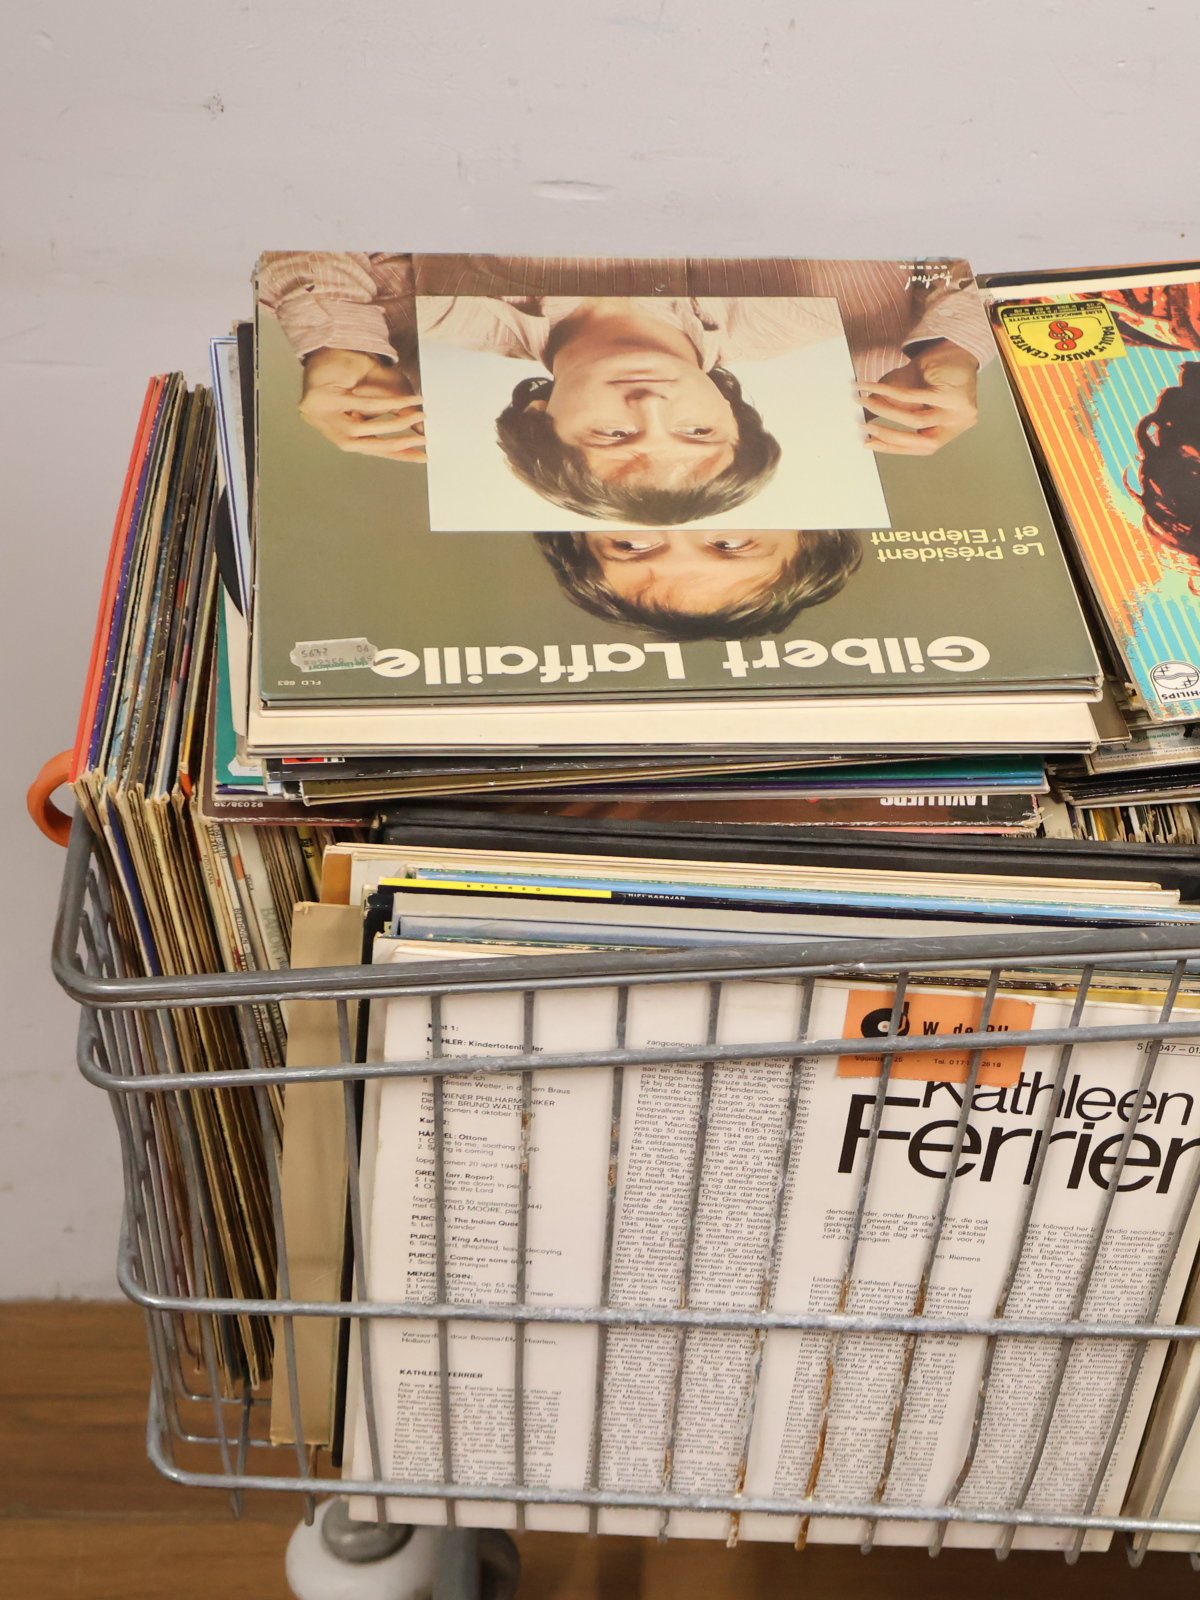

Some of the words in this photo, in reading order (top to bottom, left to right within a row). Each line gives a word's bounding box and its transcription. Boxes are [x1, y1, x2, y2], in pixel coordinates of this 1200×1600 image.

[1093, 325, 1116, 353] PAUL'S
[1009, 334, 1050, 359] CENTER
[1050, 348, 1096, 362] MUSIC
[1014, 525, 1040, 541] et
[877, 545, 1004, 563] Président
[1012, 541, 1046, 557] Le
[722, 635, 991, 678] Gilbert
[370, 642, 687, 685] Laffaille
[465, 882, 543, 892] STEREO
[426, 1036, 467, 1047] MHLER:
[547, 1086, 571, 1095] Braus
[724, 1085, 770, 1096] Henderson.
[475, 1095, 556, 1107] PHILHARMNIKER
[923, 1070, 1195, 1126] Kathleen
[457, 1099, 491, 1109] BRUNO
[481, 1110, 512, 1118] oktober
[711, 1111, 764, 1122] platendebuut
[663, 1120, 698, 1130] Maurice
[458, 1133, 488, 1142] Ottone
[464, 1147, 494, 1156] coming
[482, 1142, 516, 1151] soothing
[480, 1161, 498, 1171] april
[472, 1180, 495, 1188] down
[466, 1204, 503, 1214] MOORE,
[476, 1199, 519, 1209] september
[453, 1216, 469, 1225] The
[470, 1217, 497, 1226] Indian
[866, 1217, 900, 1227] geweest
[882, 1212, 904, 1220] onder
[907, 1212, 930, 1221] Bruno
[975, 1218, 991, 1226] ook
[447, 1224, 476, 1232] wander
[871, 1223, 894, 1232] heeft.
[1042, 1223, 1076, 1232] followed
[1105, 1227, 1129, 1236] studio
[1129, 1227, 1168, 1237] recording
[957, 1229, 988, 1239] oktober
[1120, 1233, 1162, 1243] September
[450, 1235, 472, 1245] King
[473, 1236, 499, 1245] Arthur
[525, 1247, 563, 1257] decoying
[449, 1254, 475, 1263] Come
[488, 1257, 509, 1265] sons
[948, 1253, 982, 1263] Riemens
[458, 1261, 489, 1270] trumpet
[858, 1278, 892, 1288] Kathleen
[401, 1337, 432, 1345] Holland
[398, 1368, 441, 1378] KATHLEE
[447, 1370, 485, 1380] FERRIER
